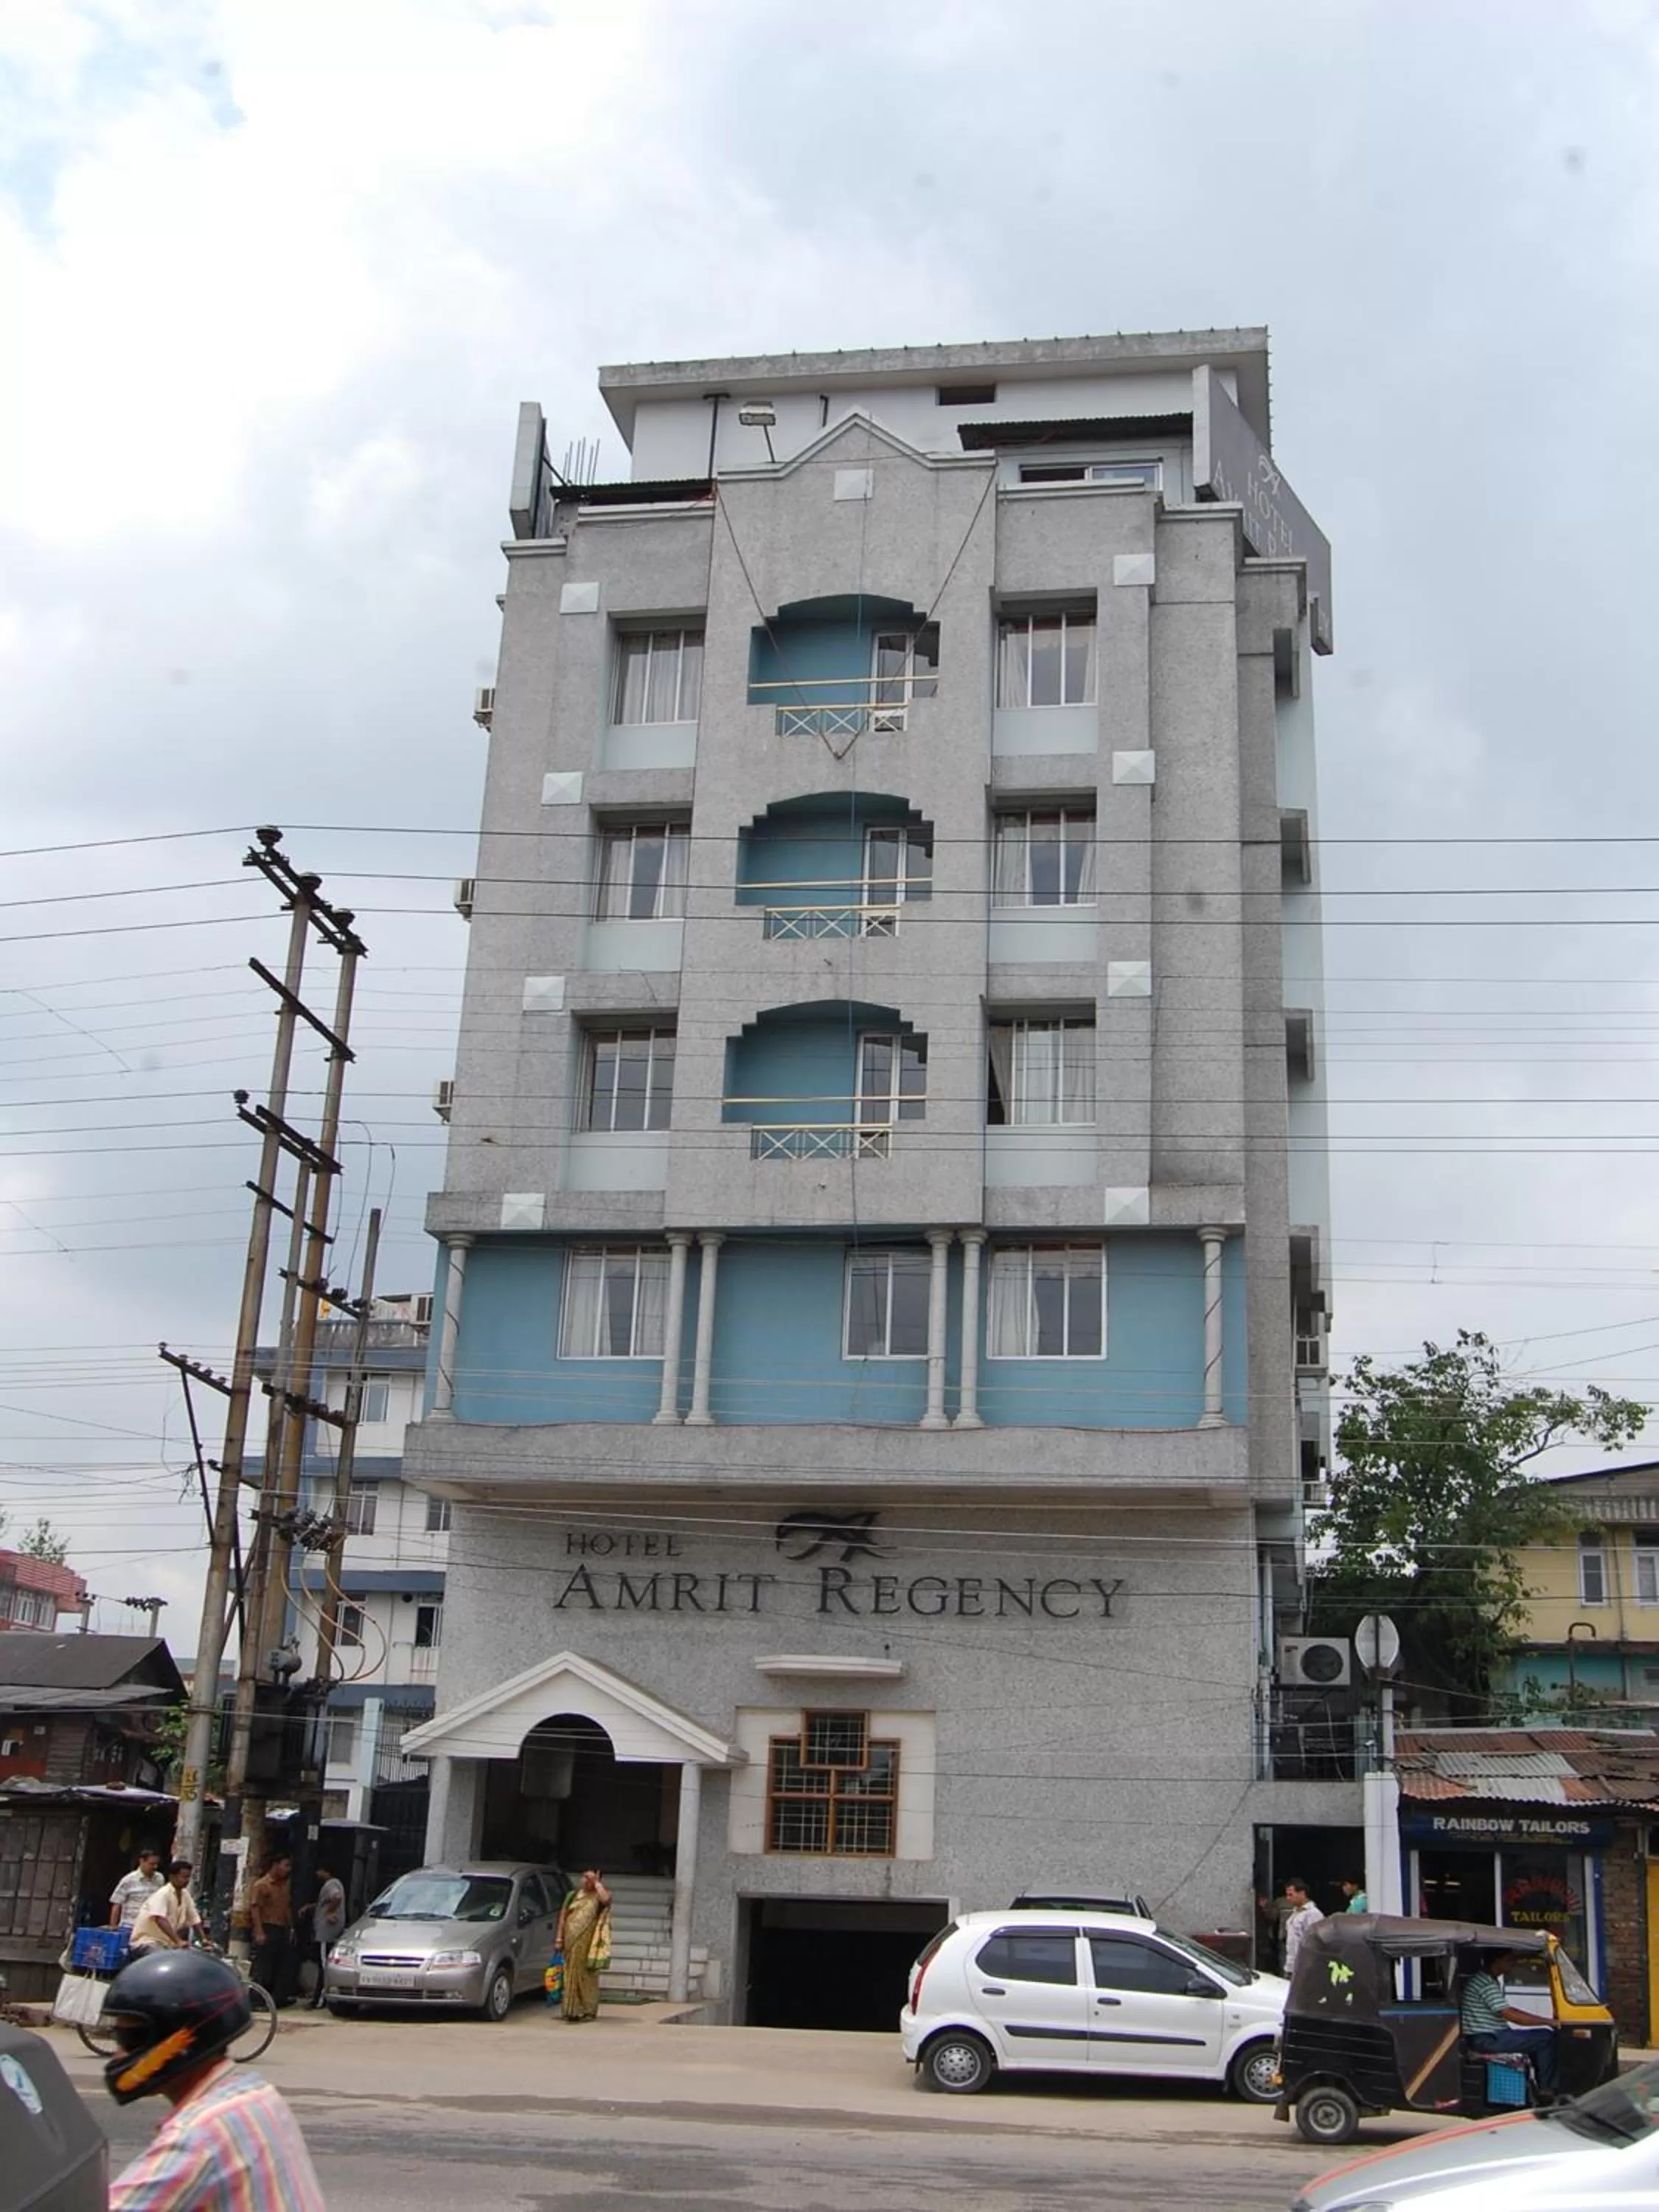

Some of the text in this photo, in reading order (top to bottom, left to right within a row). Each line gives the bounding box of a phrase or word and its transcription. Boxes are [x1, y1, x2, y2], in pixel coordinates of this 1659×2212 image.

[566, 1532, 684, 1557] HOTEL
[553, 1563, 1124, 1618] AMRIT REGENCY
[1433, 1816, 1591, 1835] RAINBOW TAILORS
[1510, 1910, 1571, 1924] TAILORS
